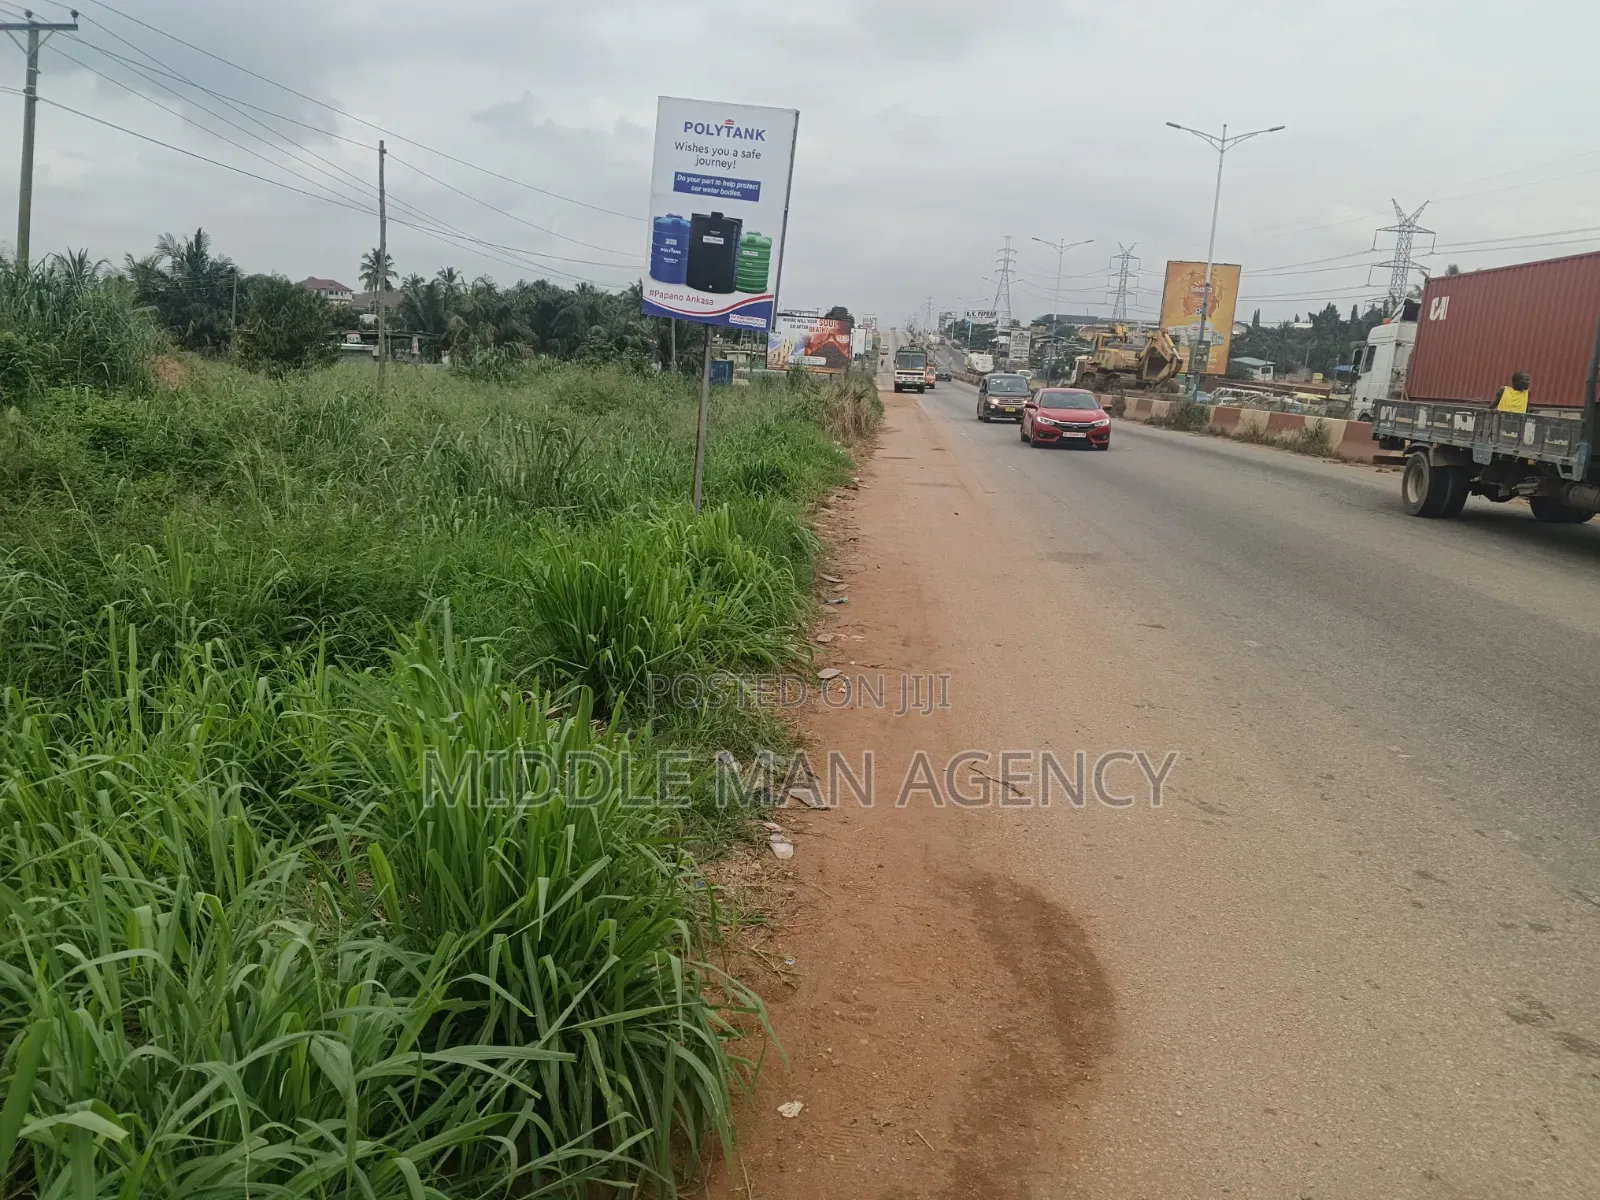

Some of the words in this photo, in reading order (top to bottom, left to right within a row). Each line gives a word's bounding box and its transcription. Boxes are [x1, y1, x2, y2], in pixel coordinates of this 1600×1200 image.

[684, 121, 766, 141] POLYTANK
[674, 141, 710, 155] Wishes
[711, 147, 730, 157] you
[732, 149, 739, 158] a
[740, 148, 762, 160] safe
[695, 155, 737, 169] journey!
[677, 174, 686, 182] Do
[722, 180, 736, 188] help
[736, 182, 759, 190] protect
[1190, 285, 1213, 293] Seaa
[649, 289, 685, 303] #Papano
[685, 293, 714, 306] Ankasa
[818, 319, 838, 328] SOUL
